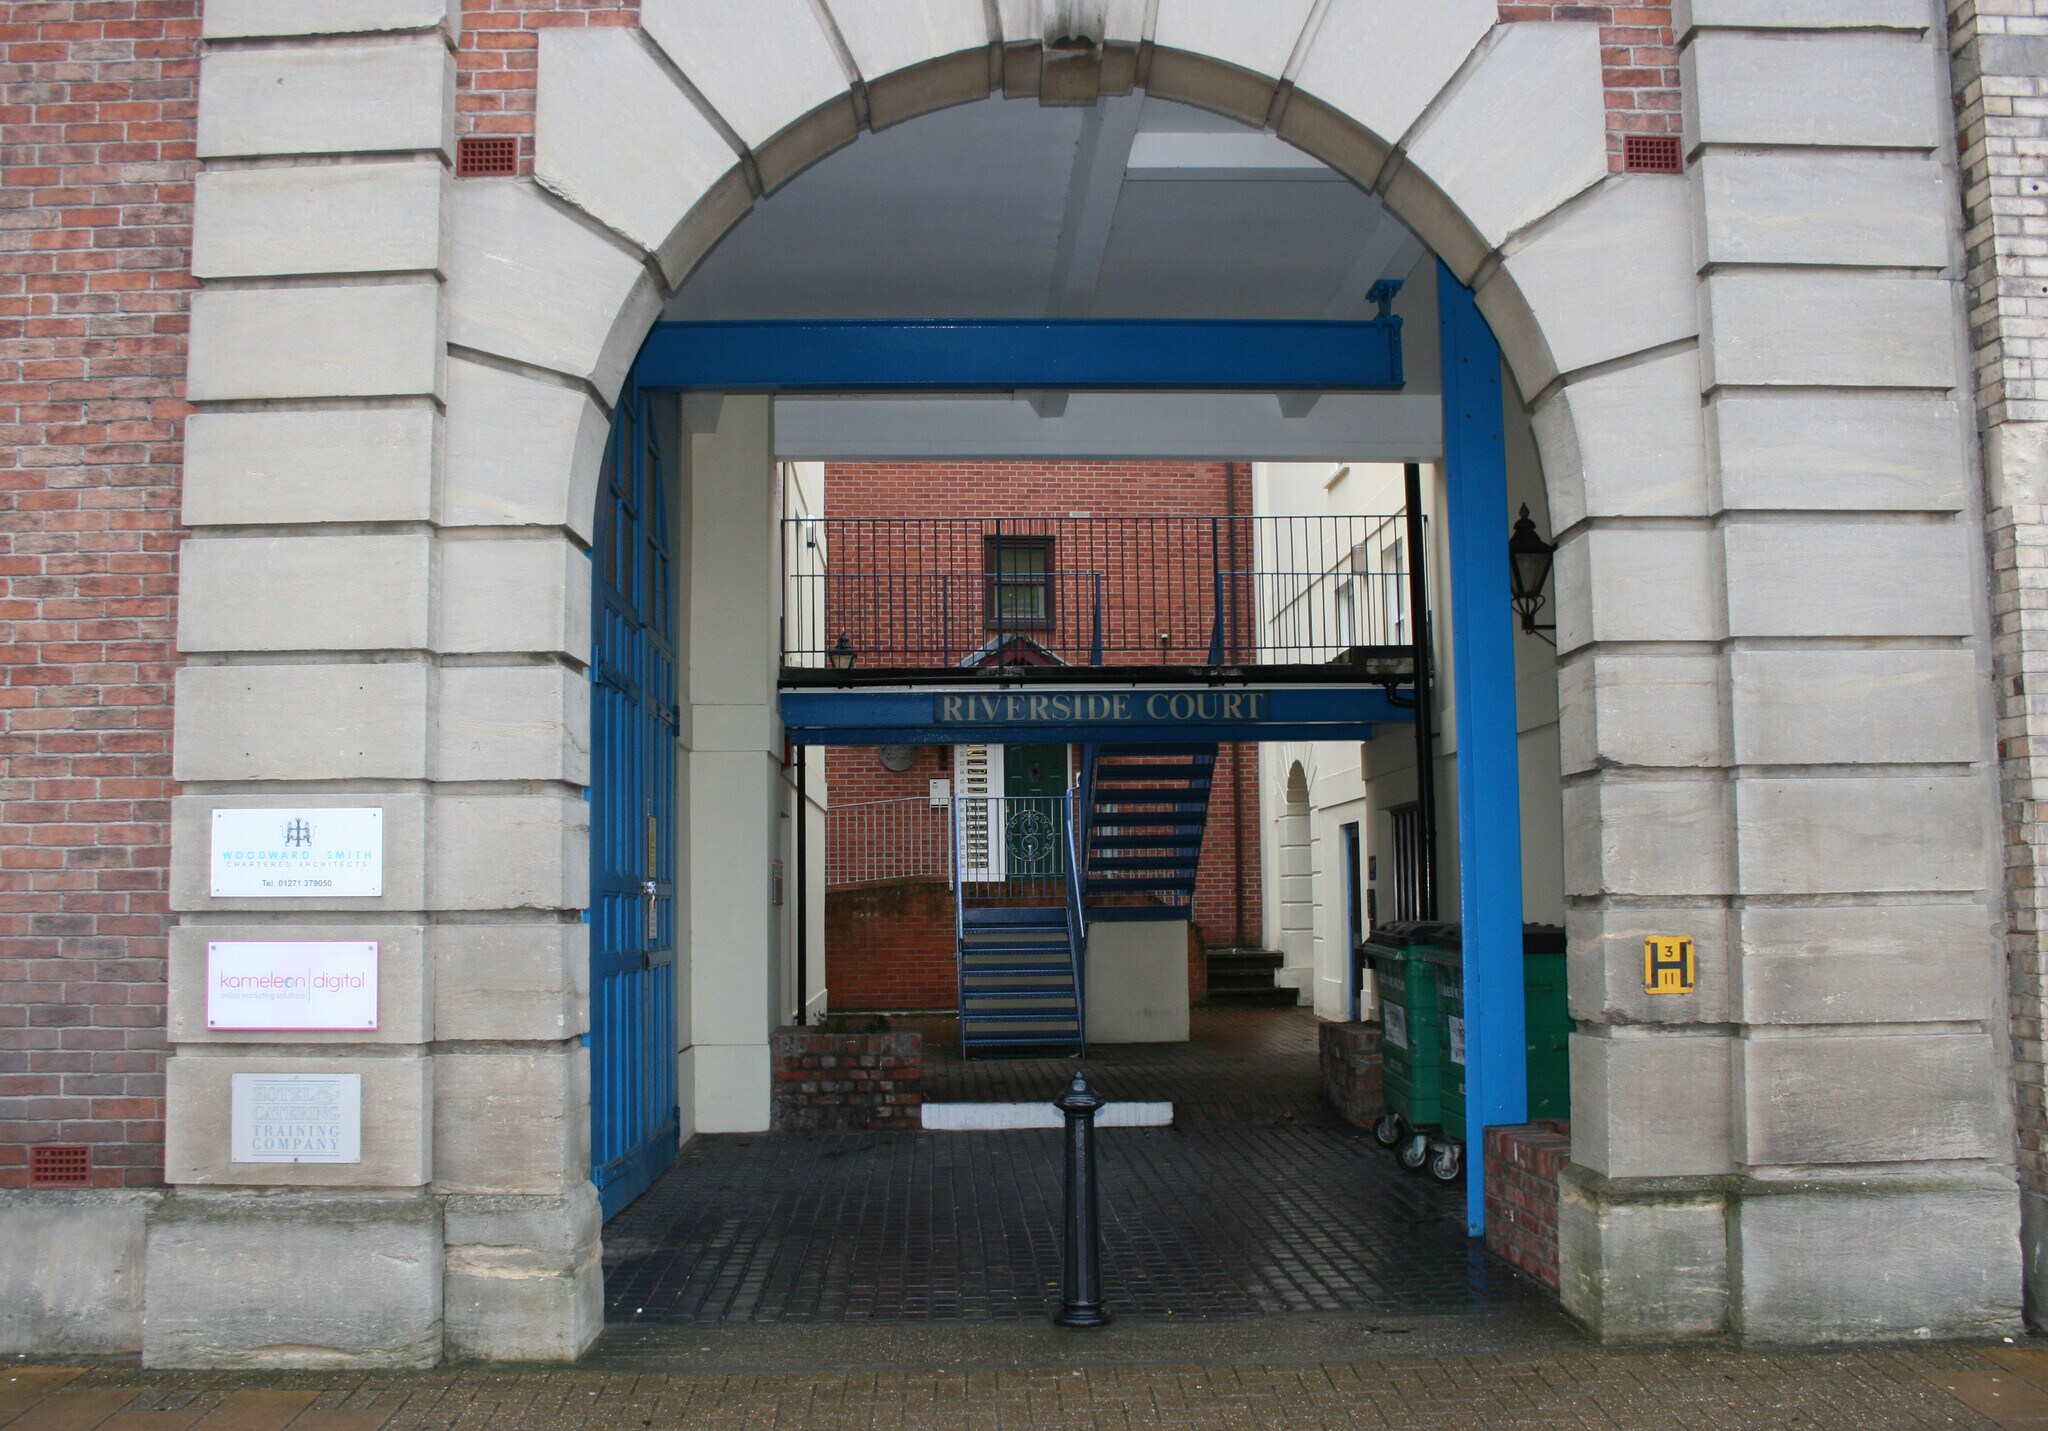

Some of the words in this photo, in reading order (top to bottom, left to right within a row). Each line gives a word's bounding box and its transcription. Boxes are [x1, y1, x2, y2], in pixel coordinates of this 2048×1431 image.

[943, 694, 1131, 721] RIVERSIDE
[1146, 692, 1264, 720] COURT
[223, 850, 310, 859] WOODWARD
[327, 850, 372, 859] SMITH
[262, 879, 276, 887] Tel:
[278, 879, 301, 887] 01271
[304, 879, 332, 887] 379050
[1664, 945, 1673, 957] 3
[1651, 942, 1687, 988] H
[220, 971, 306, 988] kameleon
[313, 971, 365, 992] digital
[242, 992, 274, 1000] marketing
[252, 1086, 315, 1102] HOTEL
[315, 1083, 340, 1106] &
[252, 1106, 340, 1121] CATERING
[252, 1125, 340, 1137] TRAINING
[252, 1138, 340, 1150] COMPANY
